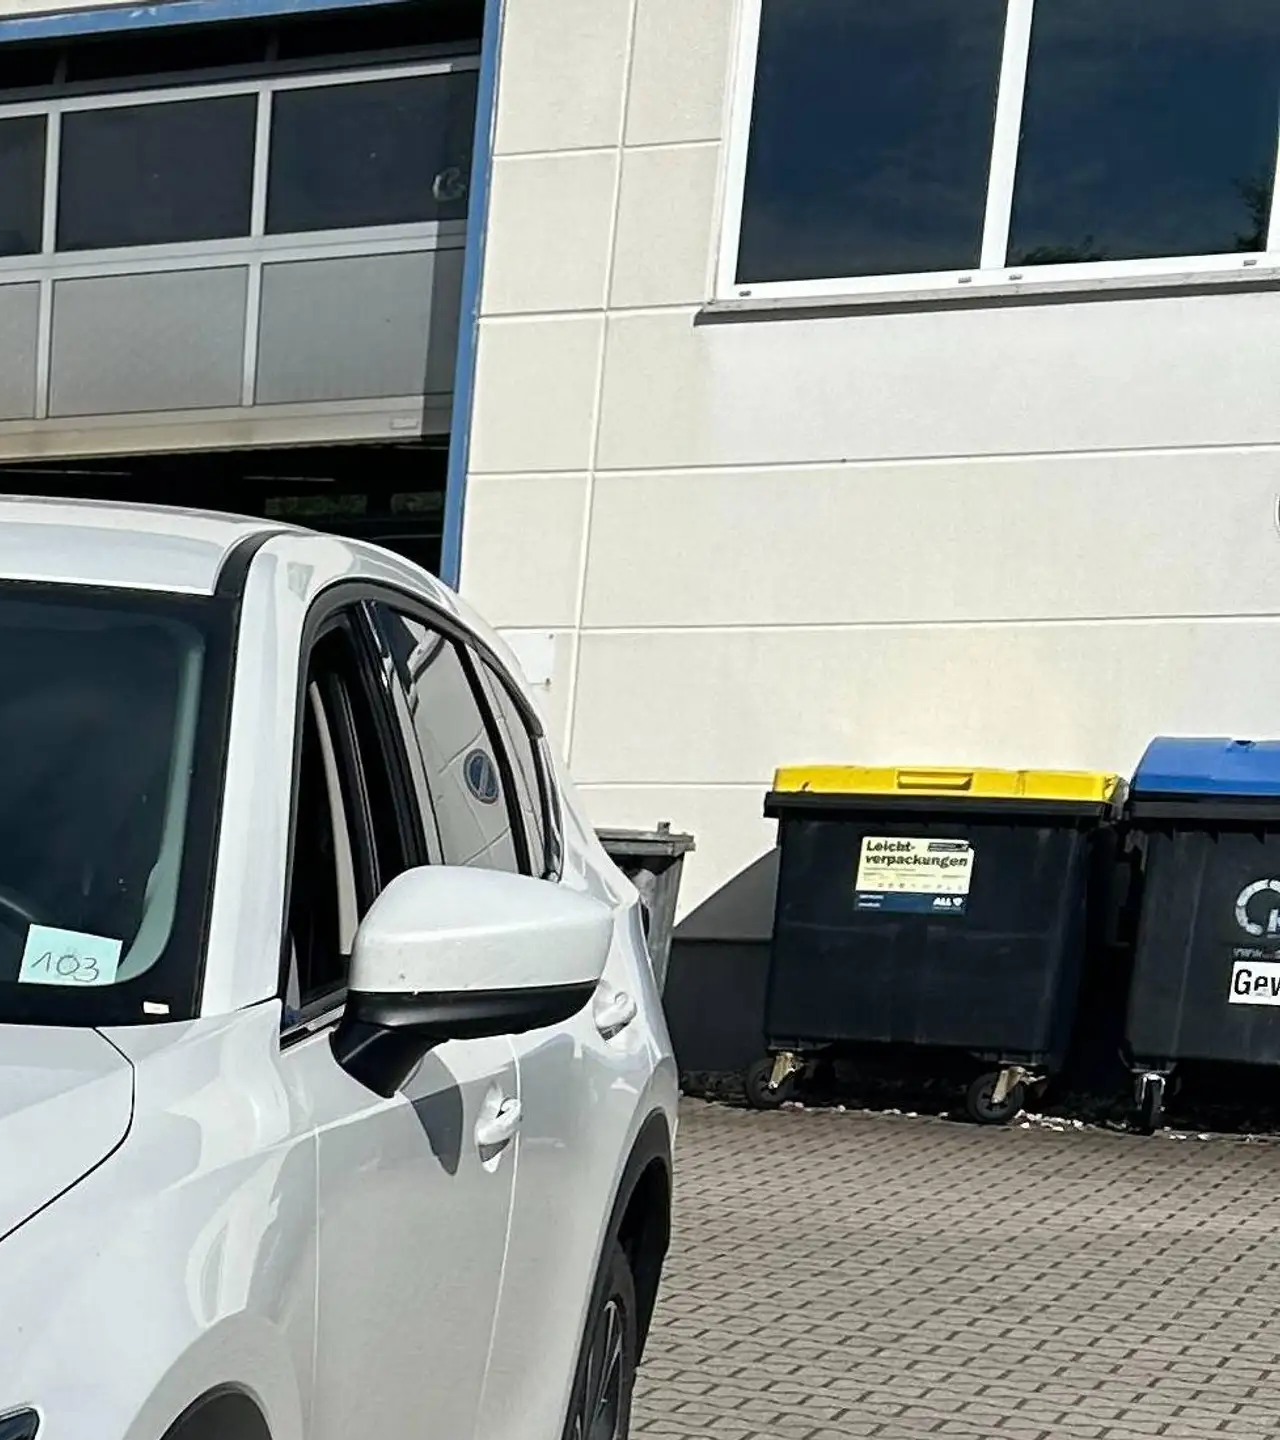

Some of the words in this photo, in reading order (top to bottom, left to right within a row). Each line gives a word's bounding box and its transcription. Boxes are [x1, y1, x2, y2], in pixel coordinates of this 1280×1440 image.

[866, 840, 915, 852] Leicht-
[865, 854, 968, 868] verpackungen
[30, 951, 100, 983] 103
